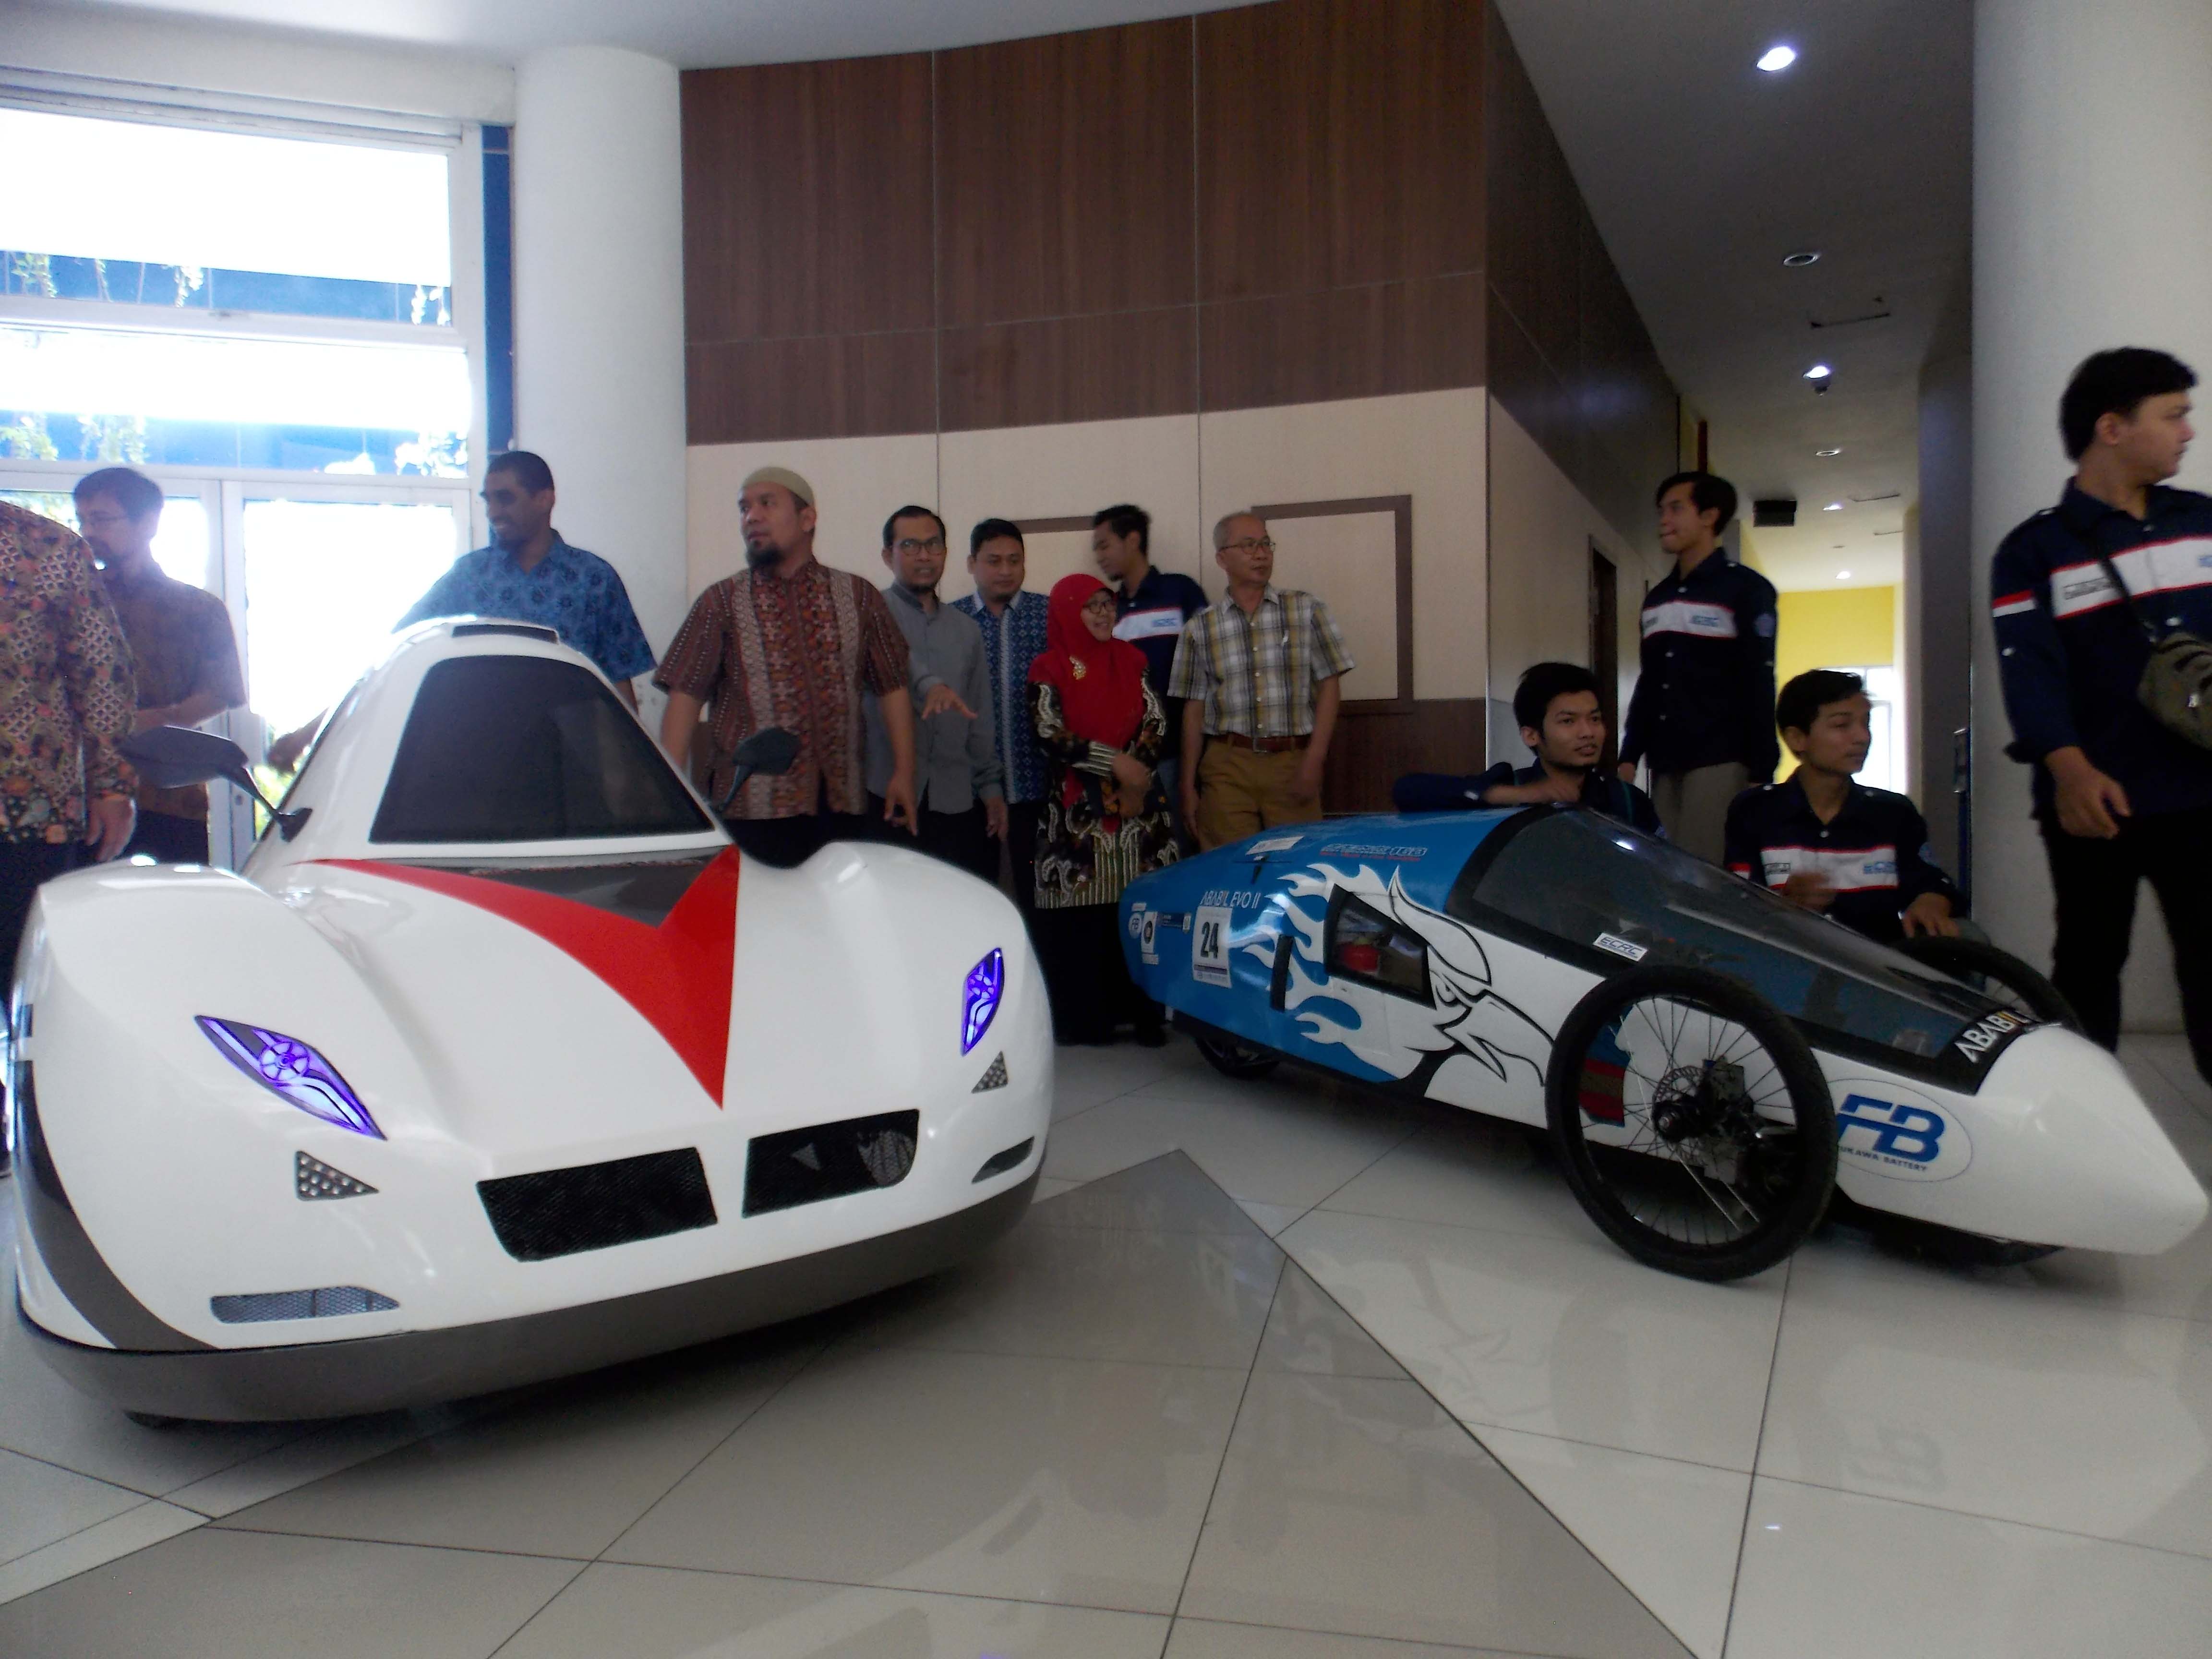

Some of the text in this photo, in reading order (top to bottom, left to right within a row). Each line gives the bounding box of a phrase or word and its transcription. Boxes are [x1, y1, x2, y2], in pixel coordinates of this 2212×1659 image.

[1200, 890, 1229, 906] ABABIL
[1230, 890, 1251, 909] EVO
[1201, 921, 1219, 959] 24
[1836, 1093, 1945, 1163] FB
[1838, 1145, 1928, 1171] UKAWA BATTERY
